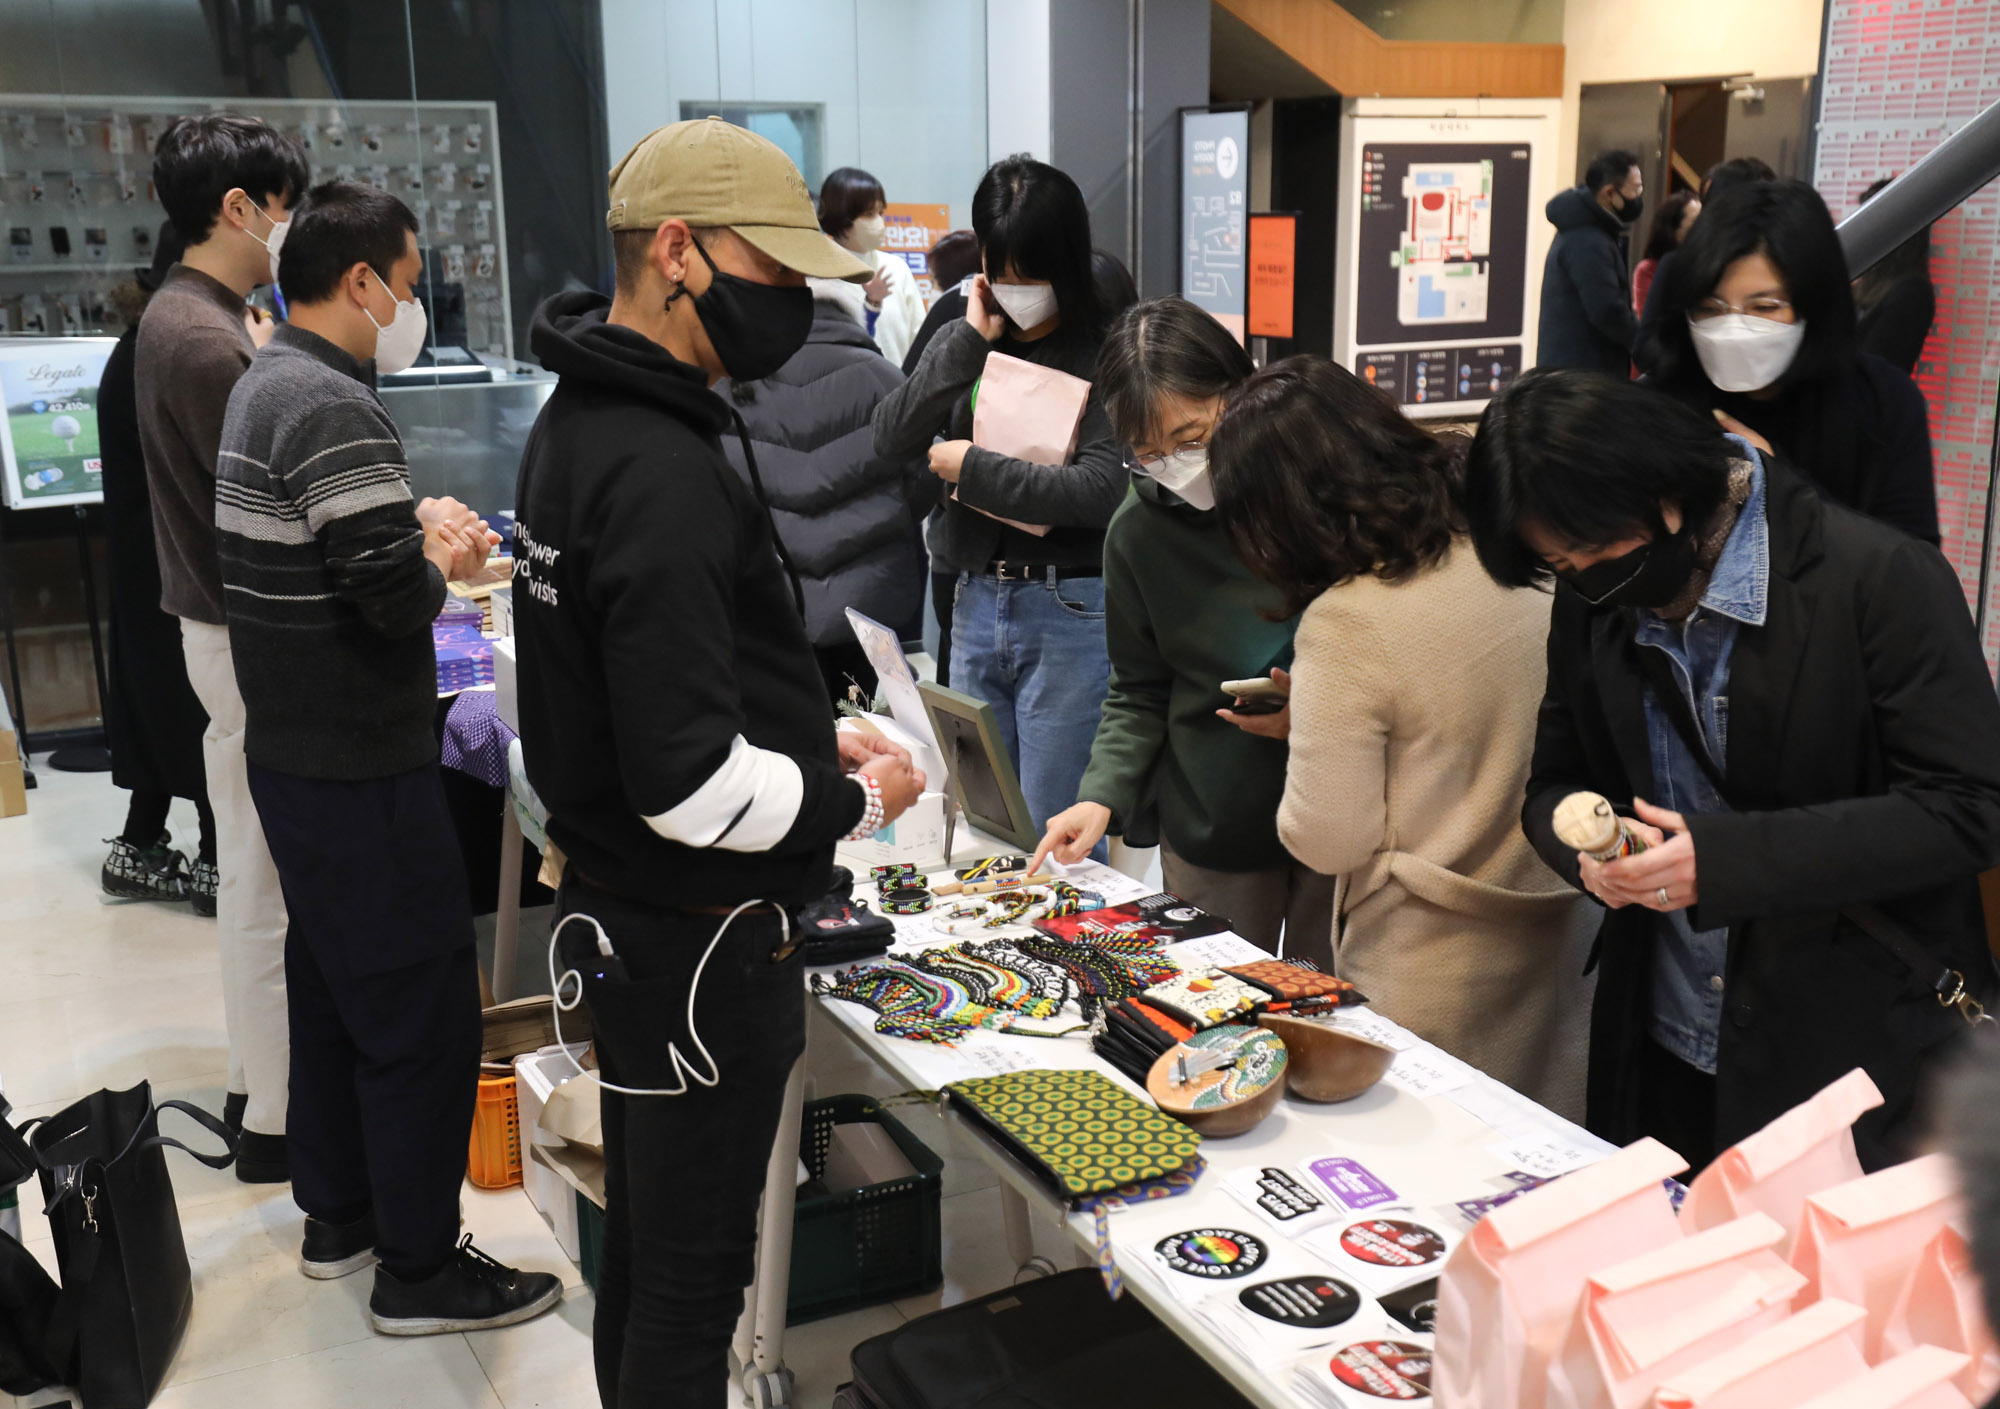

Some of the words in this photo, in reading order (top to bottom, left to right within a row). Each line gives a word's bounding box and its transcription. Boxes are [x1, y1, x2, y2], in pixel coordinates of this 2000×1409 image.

[881, 226, 929, 248] 만요!
[528, 539, 560, 566] ower
[1260, 1178, 1312, 1211] AGAINST
[1261, 1194, 1296, 1218] BOYS
[1192, 1229, 1234, 1239] LOVE
[1188, 1262, 1232, 1276] LOVE
